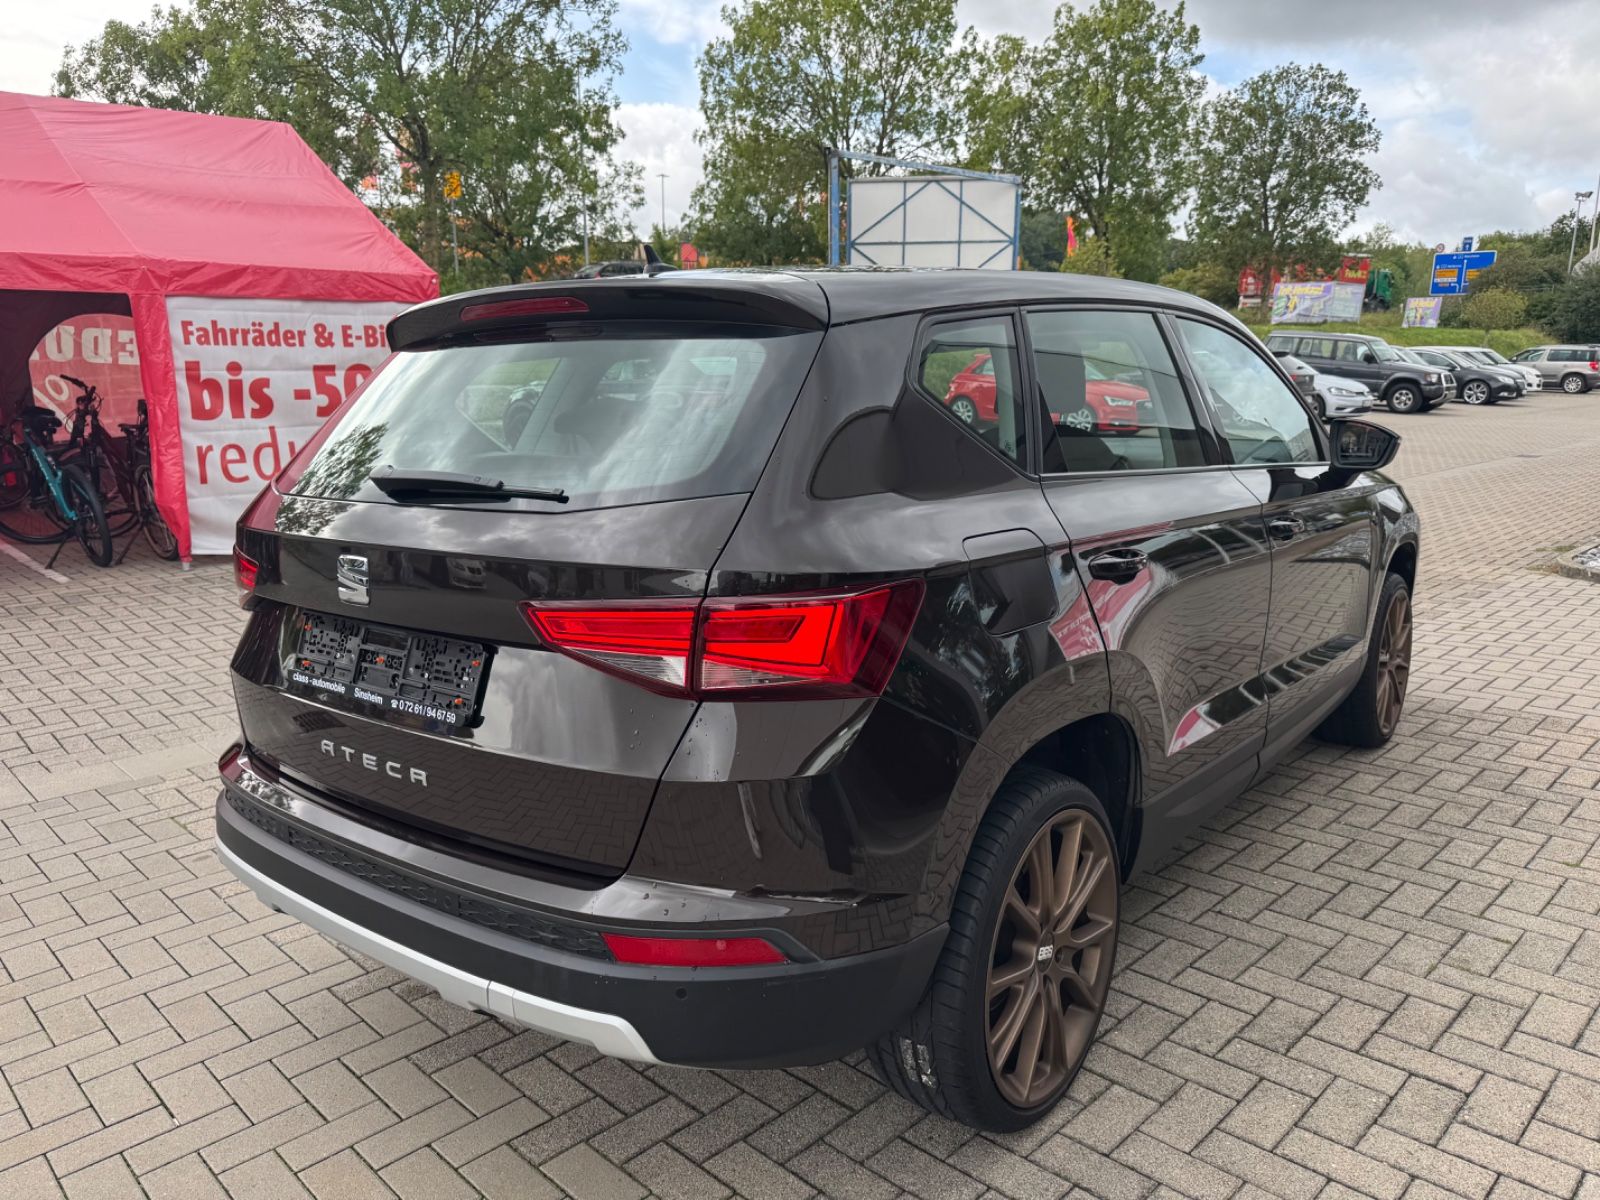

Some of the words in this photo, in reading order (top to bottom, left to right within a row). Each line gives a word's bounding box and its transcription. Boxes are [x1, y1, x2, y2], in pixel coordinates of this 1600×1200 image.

[181, 320, 306, 348] Fahrräder
[313, 323, 335, 348] &
[185, 361, 274, 420] bis
[354, 687, 383, 704] Sinsheim
[321, 739, 427, 787] ATECA
